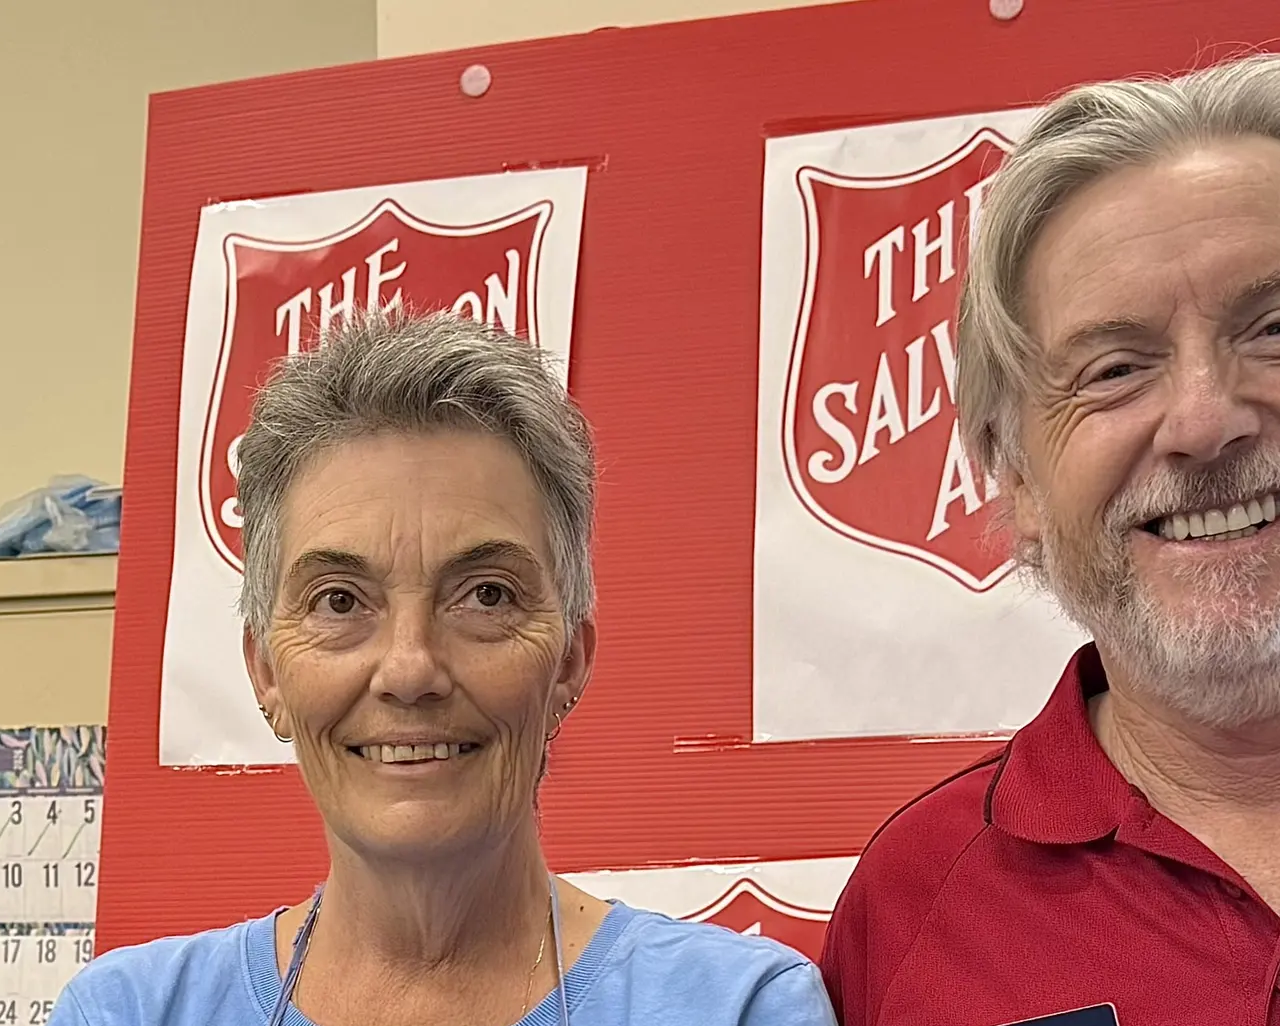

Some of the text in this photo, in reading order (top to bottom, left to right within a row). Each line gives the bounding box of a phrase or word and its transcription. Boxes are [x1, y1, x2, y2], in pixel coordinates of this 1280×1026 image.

[10, 801, 22, 825] 3
[47, 801, 58, 825] 4
[84, 801, 95, 825] 5
[2, 863, 22, 887] 10
[43, 863, 58, 887] 11
[75, 863, 95, 887] 12
[3, 939, 20, 963] 17
[37, 939, 56, 963] 18
[74, 939, 93, 963] 19
[29, 1001, 53, 1025] 25
